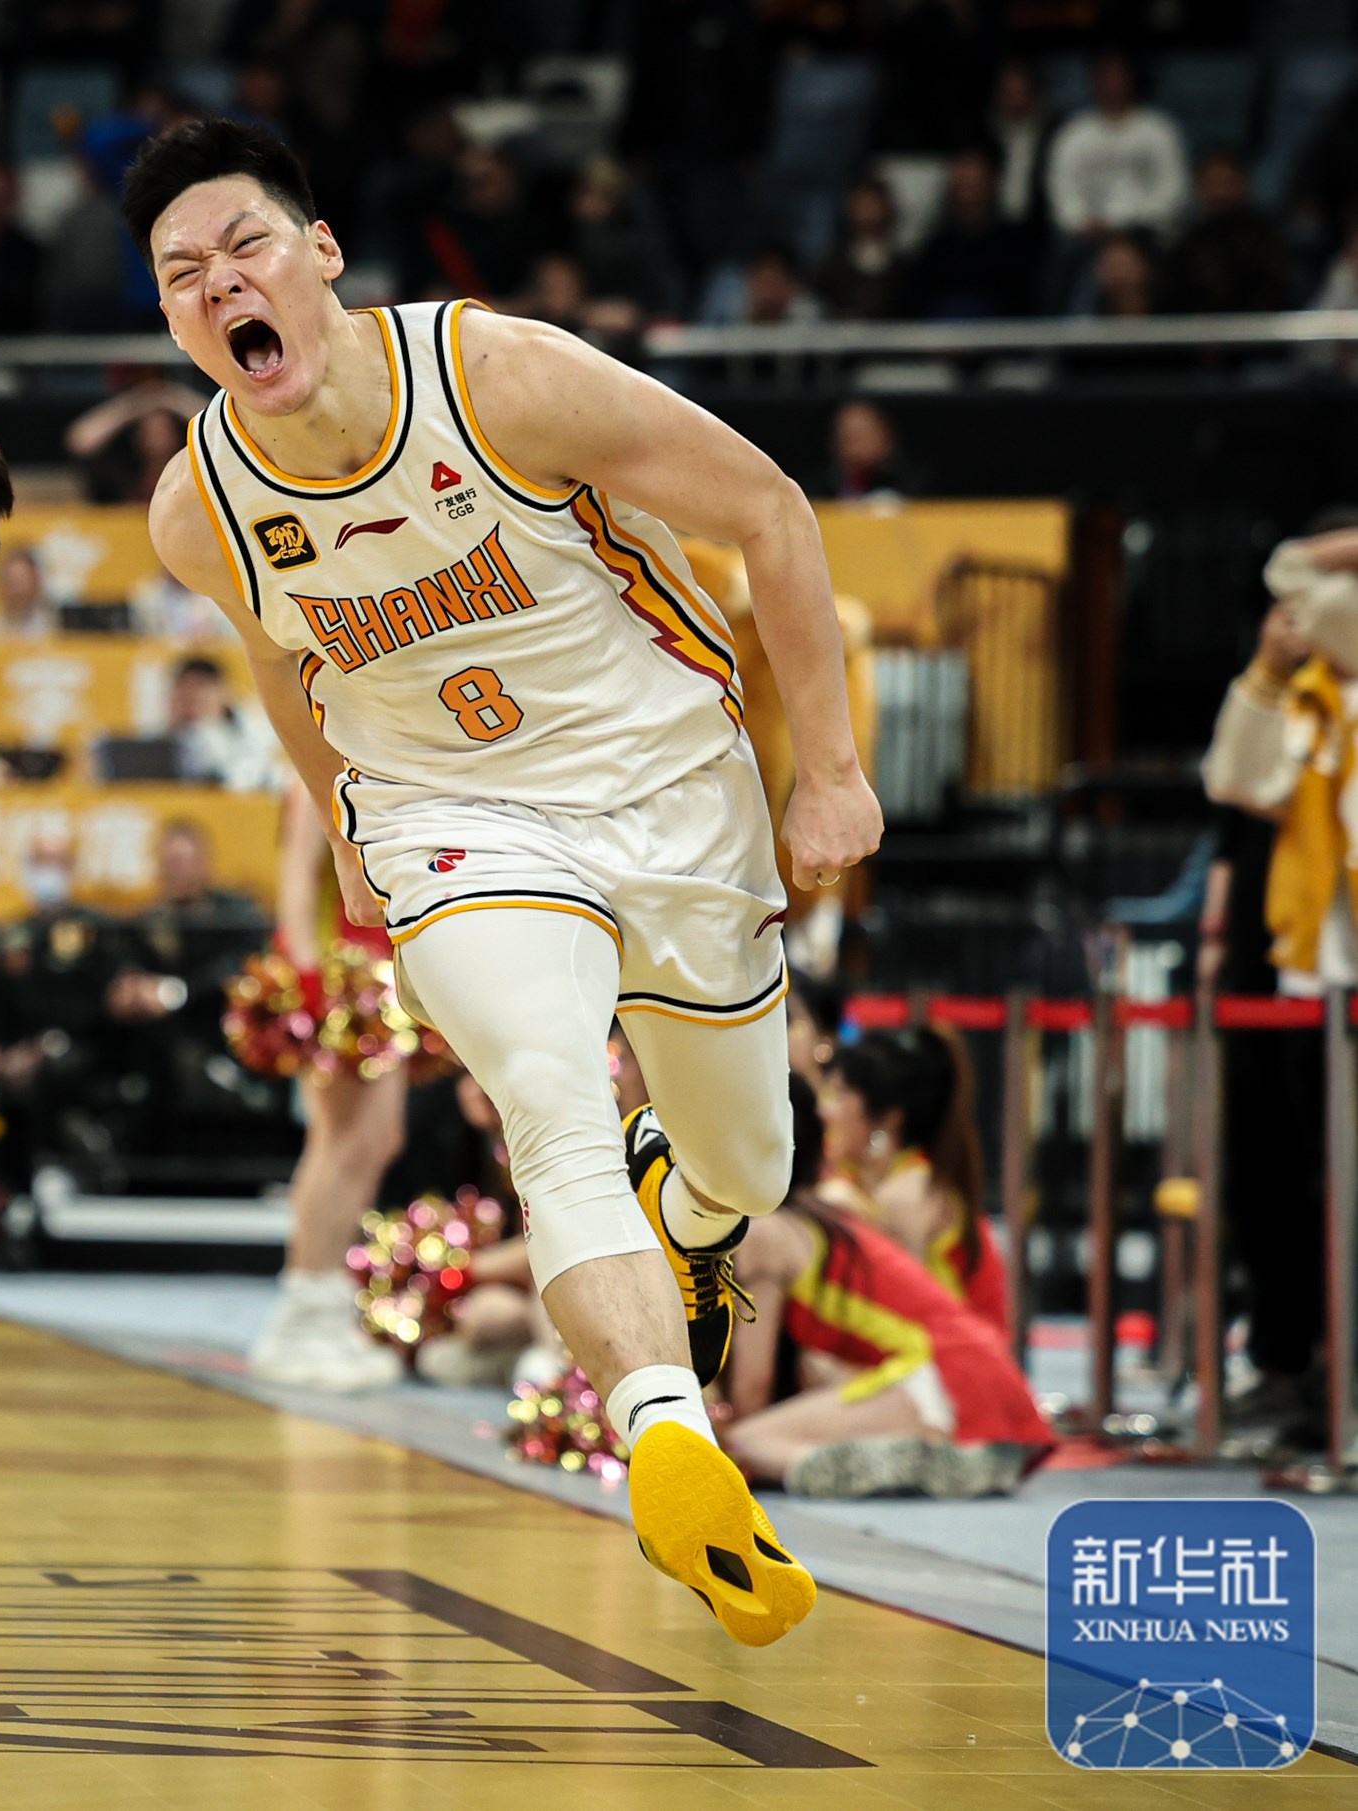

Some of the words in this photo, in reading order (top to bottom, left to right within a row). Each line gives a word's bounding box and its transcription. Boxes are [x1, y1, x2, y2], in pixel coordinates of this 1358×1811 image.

[434, 487, 477, 512] 广发银行
[447, 503, 476, 520] CGB
[280, 547, 308, 559] CBA
[284, 521, 538, 675] SHANXI
[437, 665, 524, 742] 8
